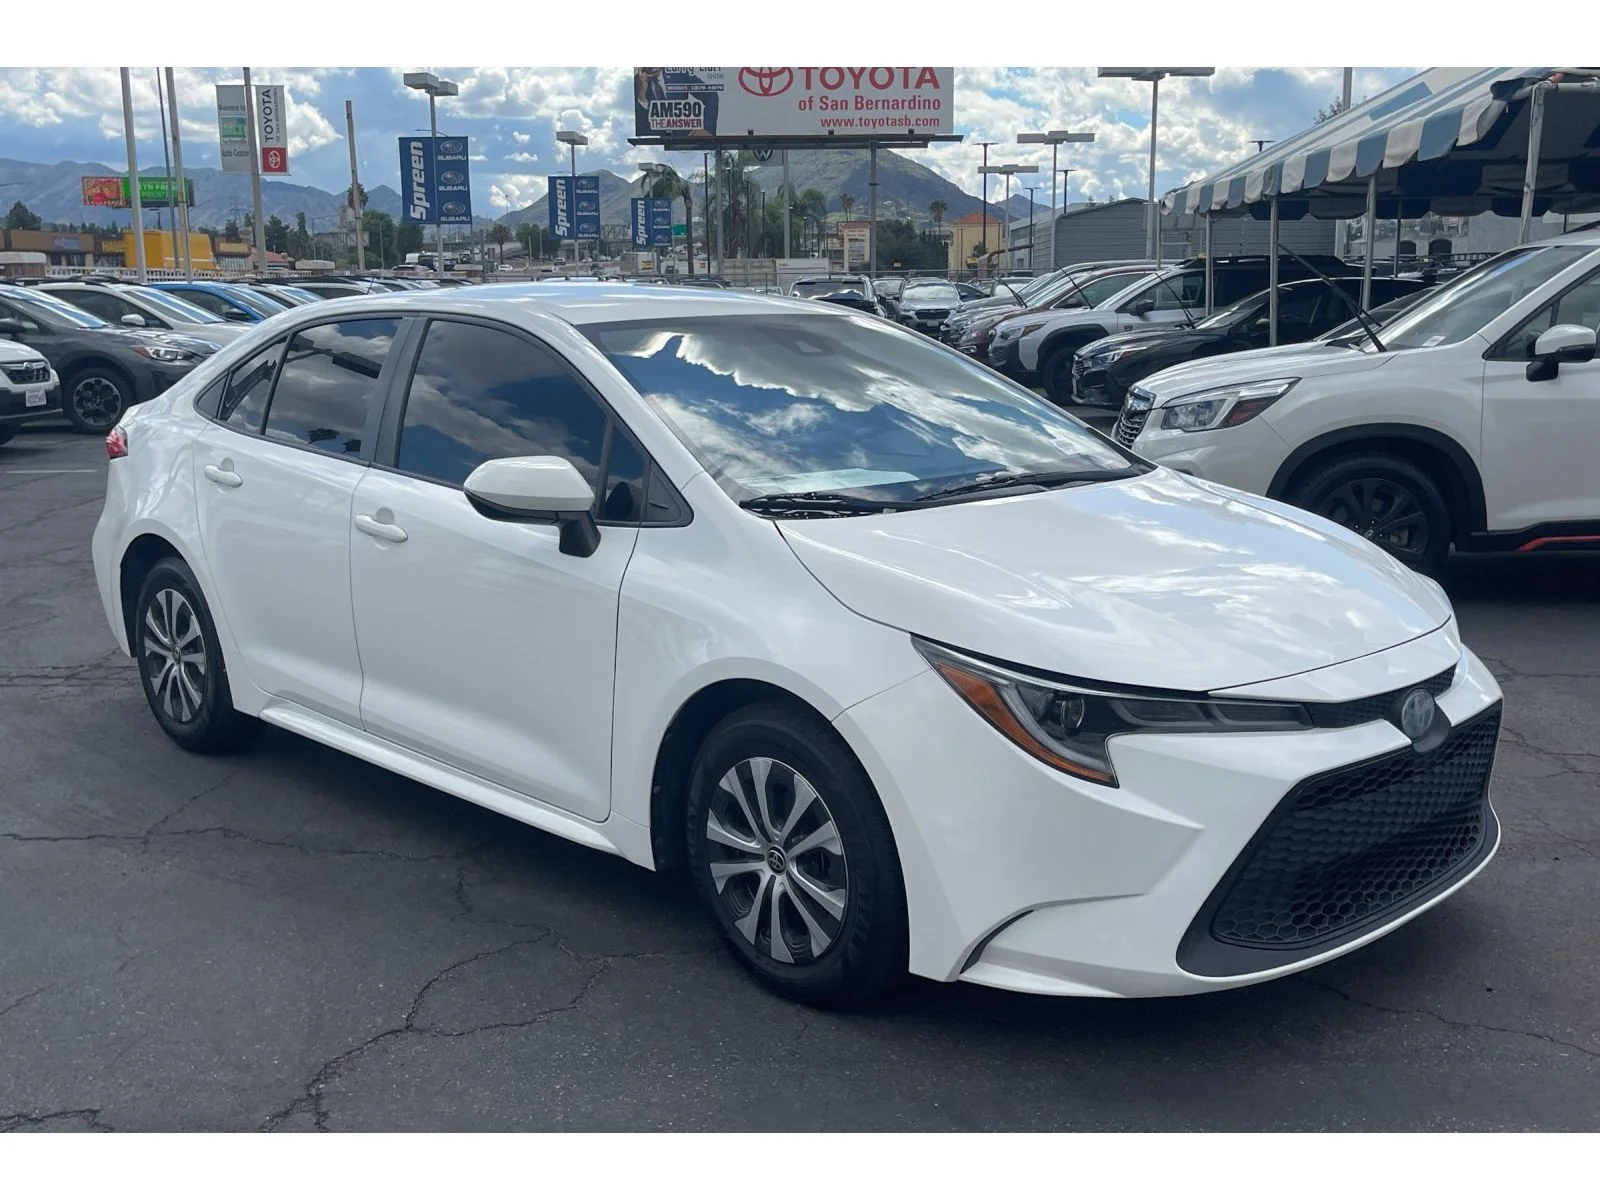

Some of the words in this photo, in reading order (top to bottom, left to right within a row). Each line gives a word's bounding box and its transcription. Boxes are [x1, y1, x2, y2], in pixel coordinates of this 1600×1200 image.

[798, 67, 941, 90] TOYOTA
[650, 101, 702, 118] AM590
[798, 96, 814, 111] of
[819, 95, 848, 111] San
[854, 95, 941, 111] Bernardino
[262, 89, 274, 142] TOYOTA
[665, 119, 702, 128] ANSWER
[820, 115, 940, 129] www.toyotasb.com
[410, 141, 430, 220] Spreen
[555, 179, 571, 237] Spreen
[636, 200, 649, 246] Spreen
